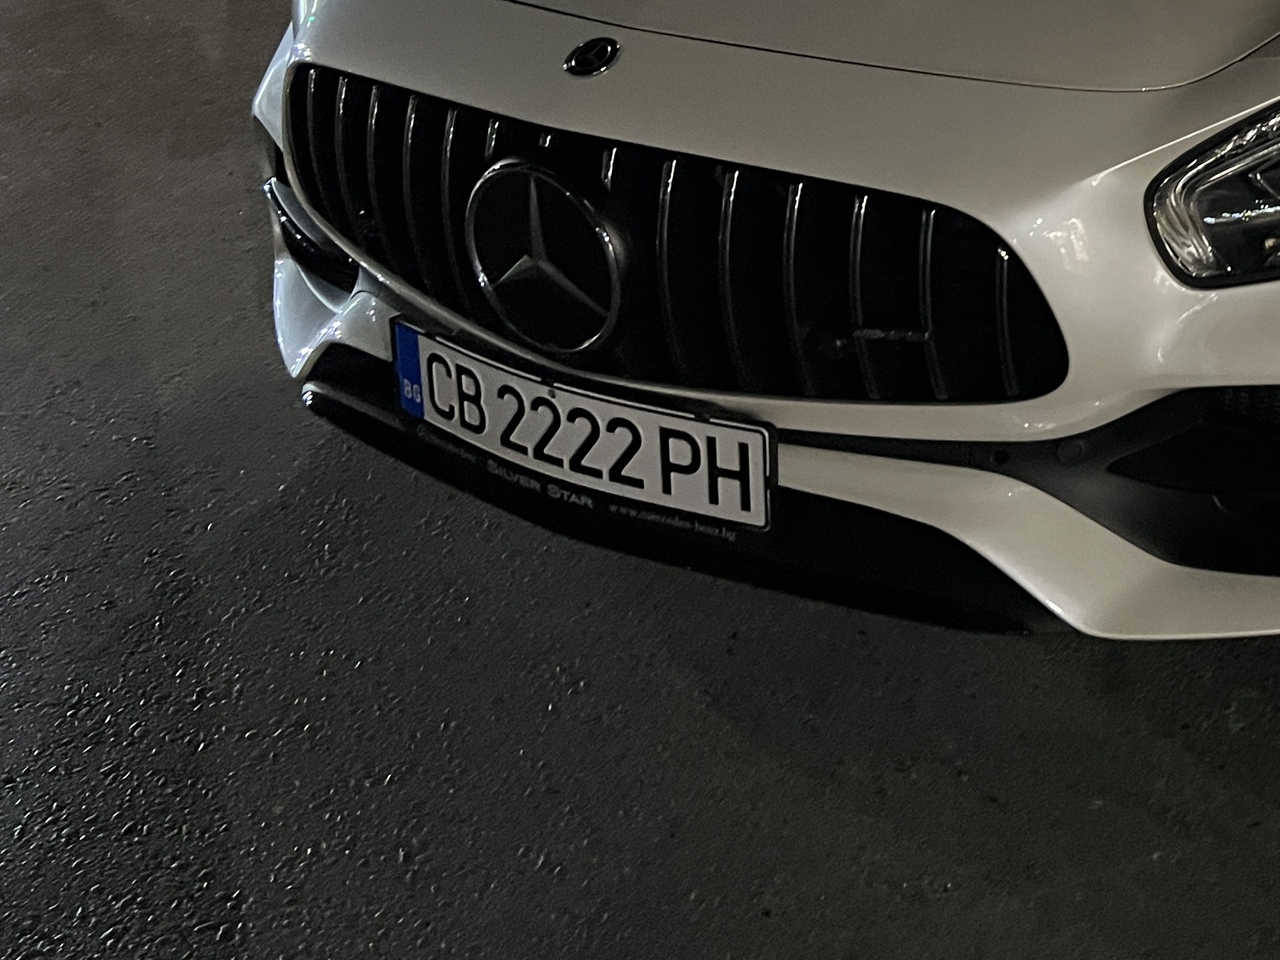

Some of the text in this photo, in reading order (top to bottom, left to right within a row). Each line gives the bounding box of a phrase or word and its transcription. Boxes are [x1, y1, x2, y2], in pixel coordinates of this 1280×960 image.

[403, 378, 421, 404] BG
[427, 352, 486, 434] CB
[497, 384, 644, 490] 2222
[659, 426, 751, 512] PH
[546, 484, 594, 509] STAR
